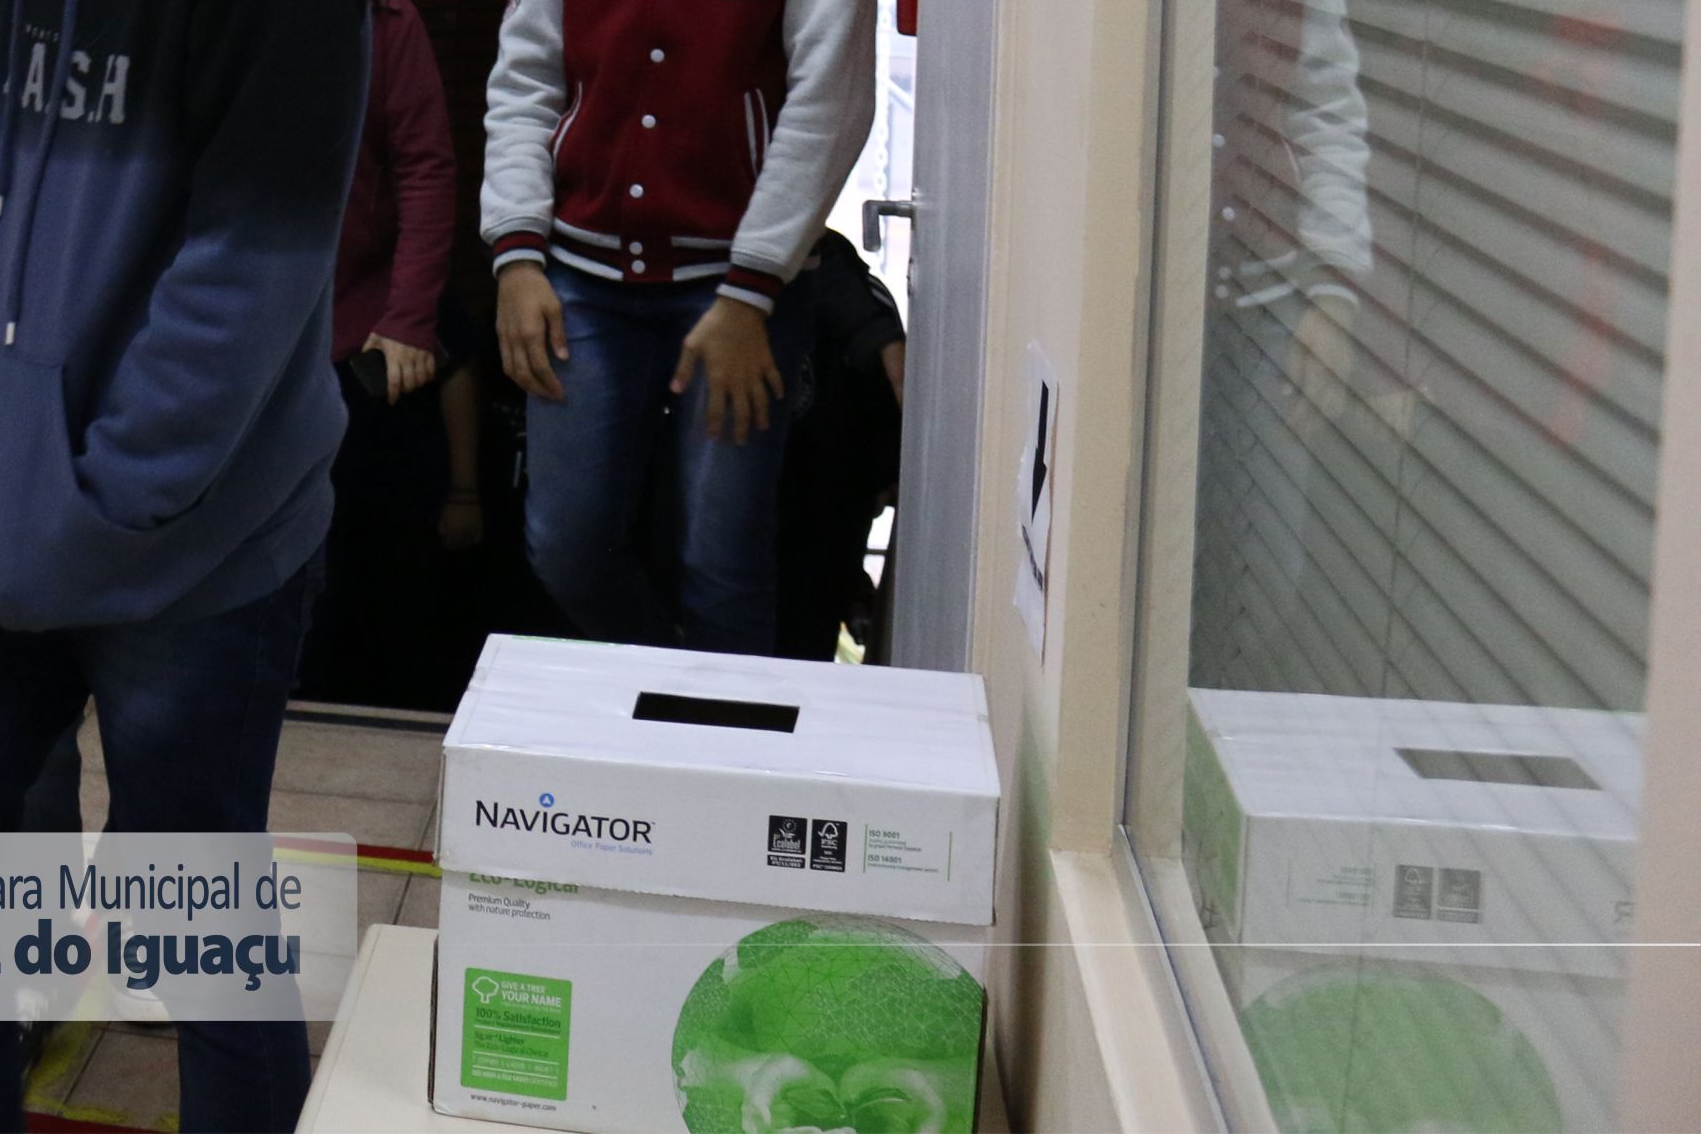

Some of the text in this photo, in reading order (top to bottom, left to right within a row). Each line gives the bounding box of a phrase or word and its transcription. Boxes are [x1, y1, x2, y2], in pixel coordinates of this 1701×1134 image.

[476, 800, 652, 844] NAVIGATOR
[868, 829, 881, 838] ISO
[571, 840, 593, 850] Office
[595, 842, 617, 853] Paper
[868, 854, 880, 862] ISO
[468, 893, 531, 909] Premium Quality
[468, 904, 551, 921] with nature protection
[501, 990, 530, 1004] YOUR
[531, 994, 562, 1008] NAME
[503, 1010, 562, 1029] Satisfaction
[470, 1093, 557, 1112] www.navigator-paper.com
